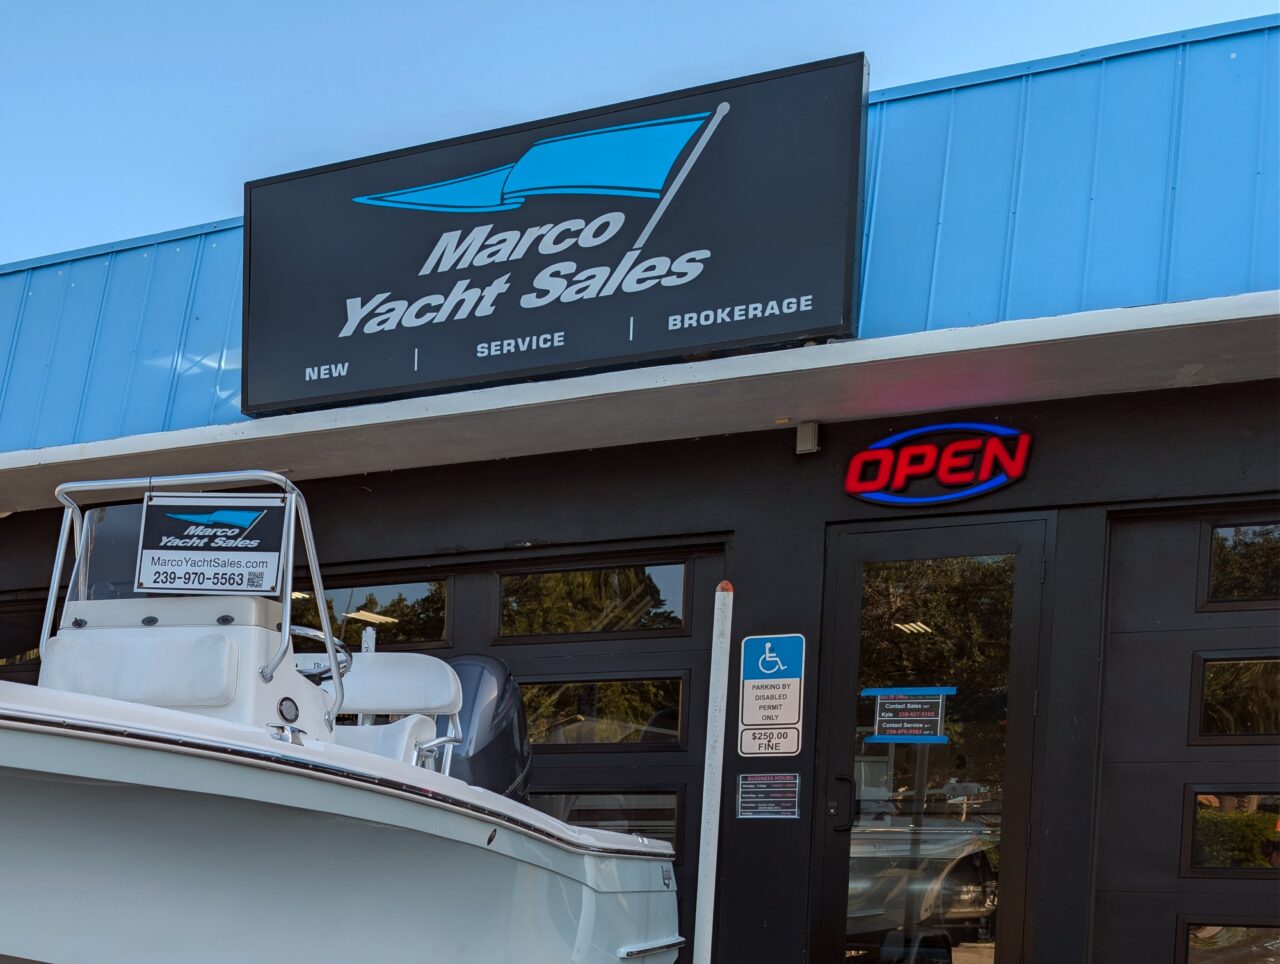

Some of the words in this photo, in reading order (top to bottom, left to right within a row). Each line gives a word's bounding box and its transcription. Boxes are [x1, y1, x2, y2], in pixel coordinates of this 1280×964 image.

[419, 211, 626, 277] Marco
[337, 272, 512, 338] Yacht
[521, 246, 712, 308] Sales
[305, 362, 349, 381] NEW
[476, 331, 566, 358] SERVICE
[668, 295, 813, 331] BROKERAGE
[844, 433, 1031, 494] OPEN
[183, 525, 239, 537] Marco
[158, 536, 209, 548] Yacht
[210, 536, 261, 548] Sales
[150, 556, 269, 569] MarcoYachtSales.com
[153, 571, 244, 587] 239-970-5563
[755, 693, 788, 701] DISABLED
[751, 731, 788, 741] $250.00
[758, 742, 781, 751] FINE
